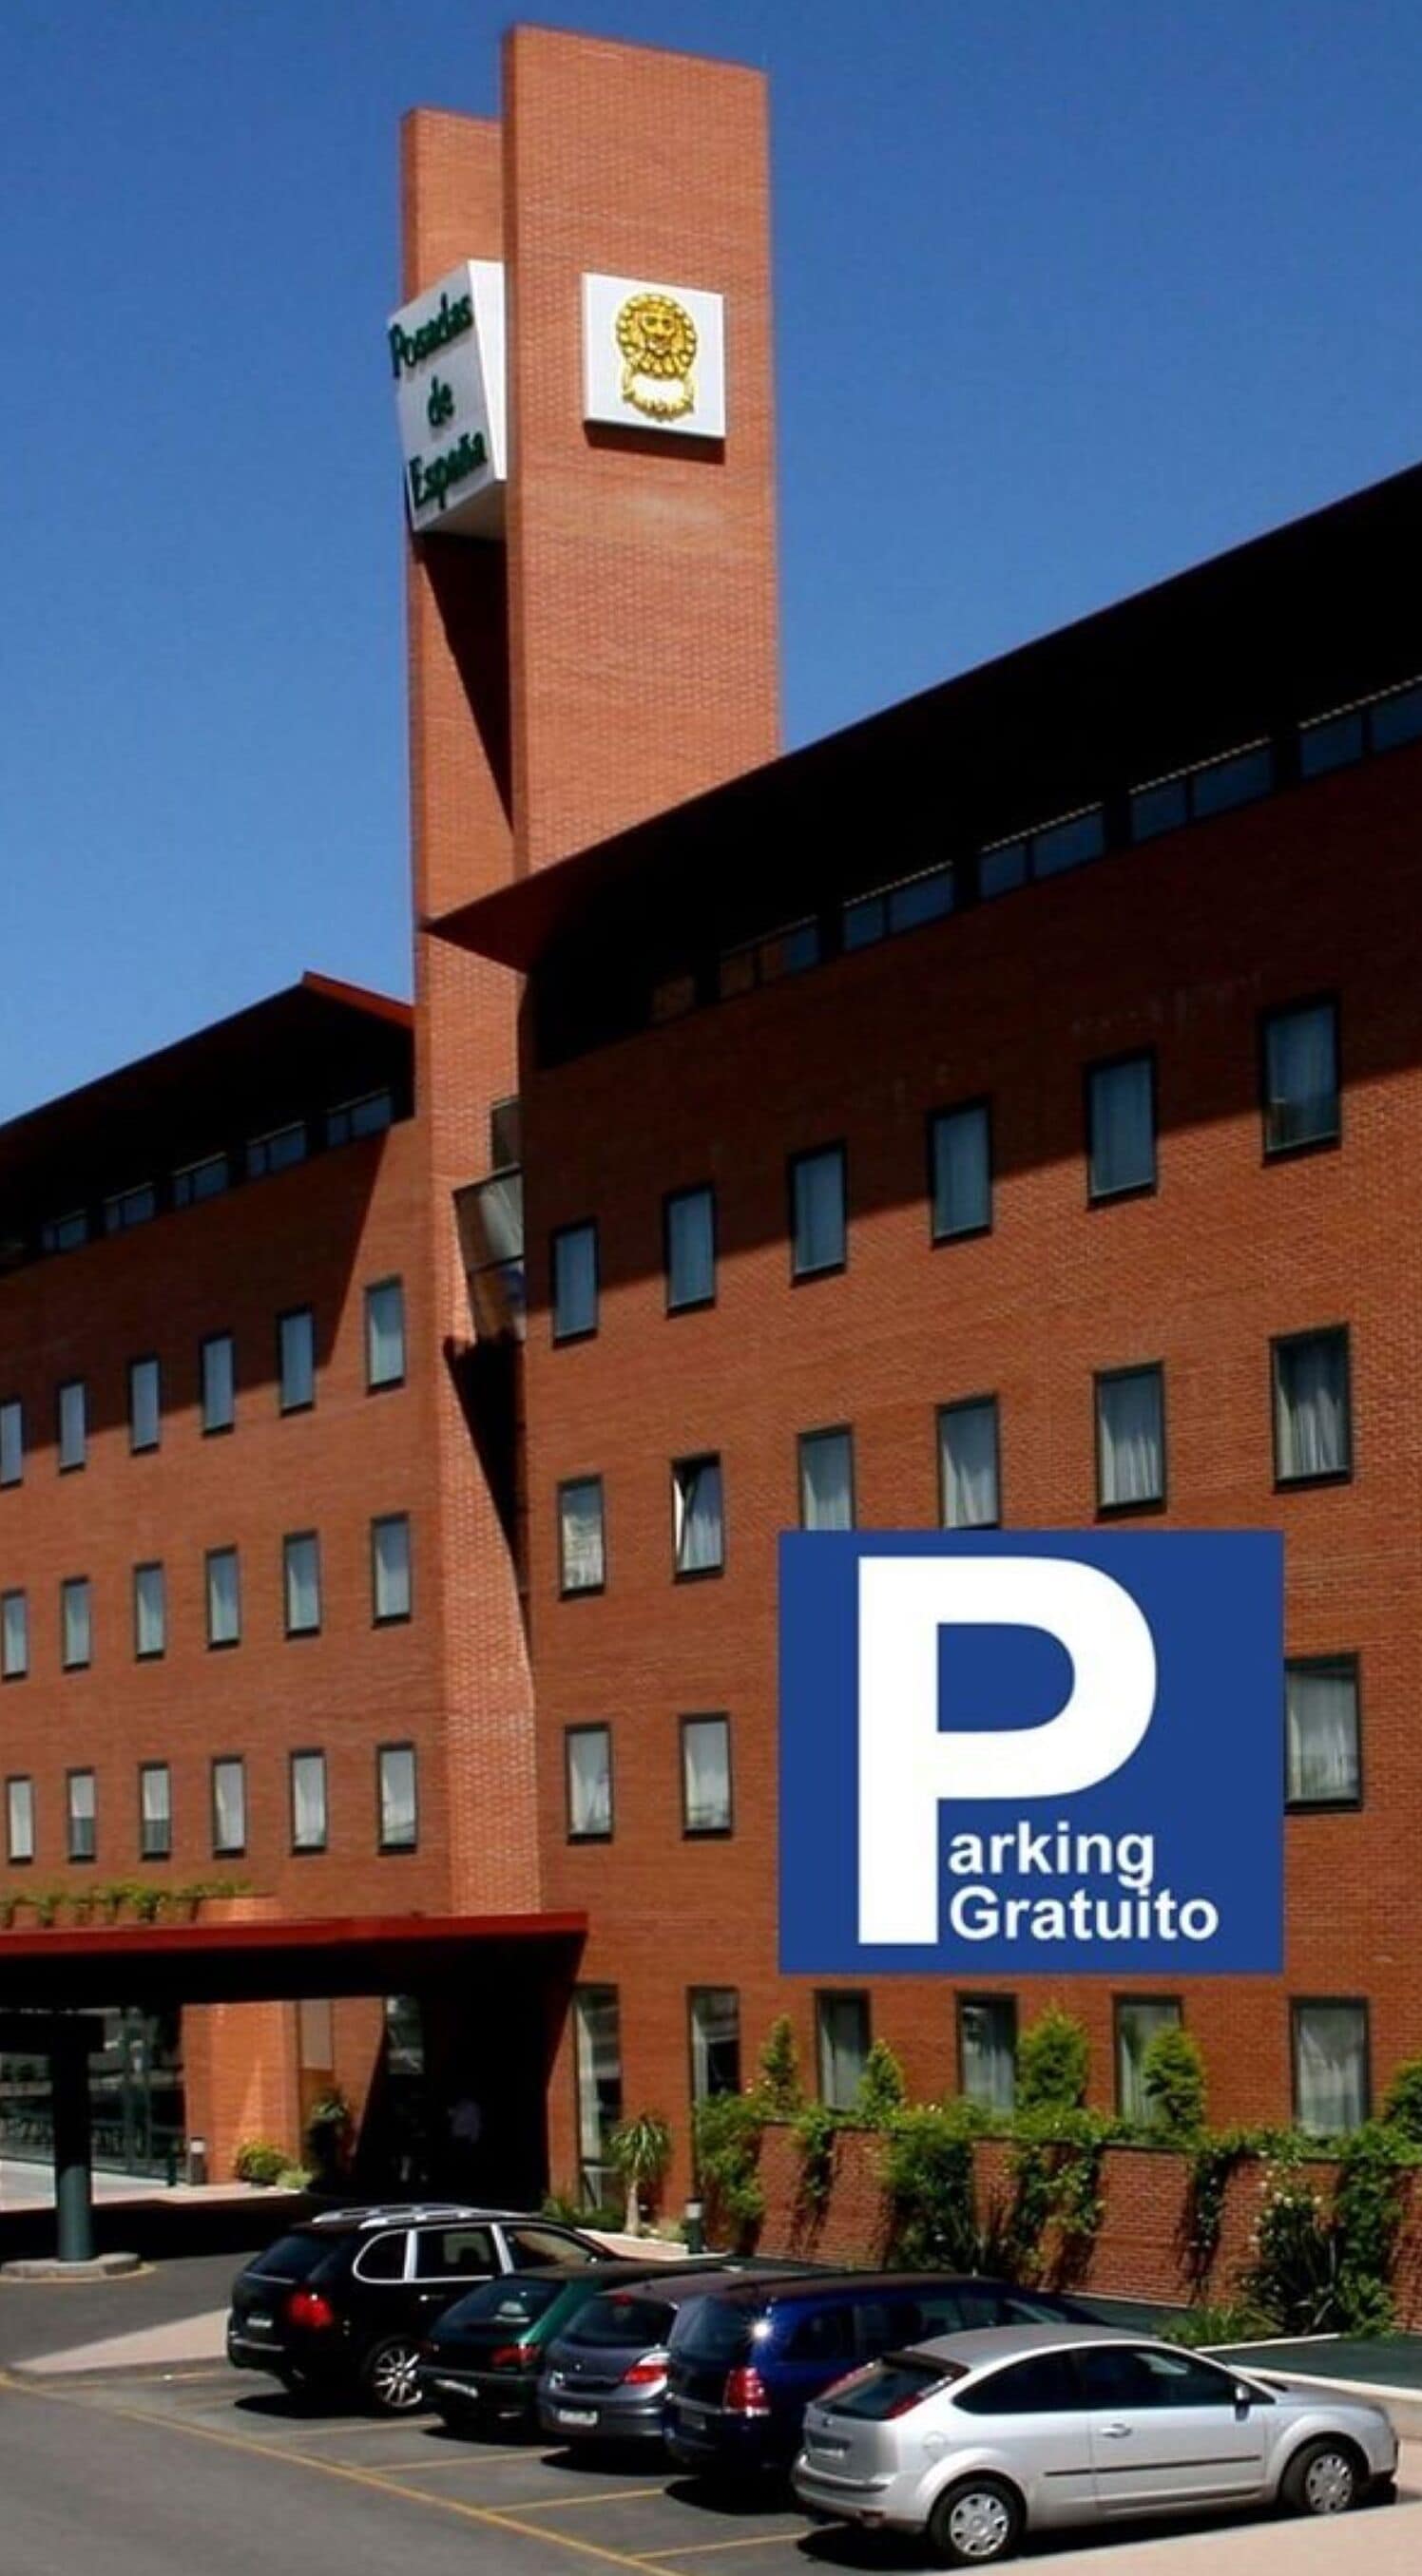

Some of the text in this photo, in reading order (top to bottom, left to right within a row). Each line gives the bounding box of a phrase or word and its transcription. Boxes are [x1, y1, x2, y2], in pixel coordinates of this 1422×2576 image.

[388, 291, 474, 378] Posadas
[427, 375, 455, 427] de
[409, 430, 488, 510] España
